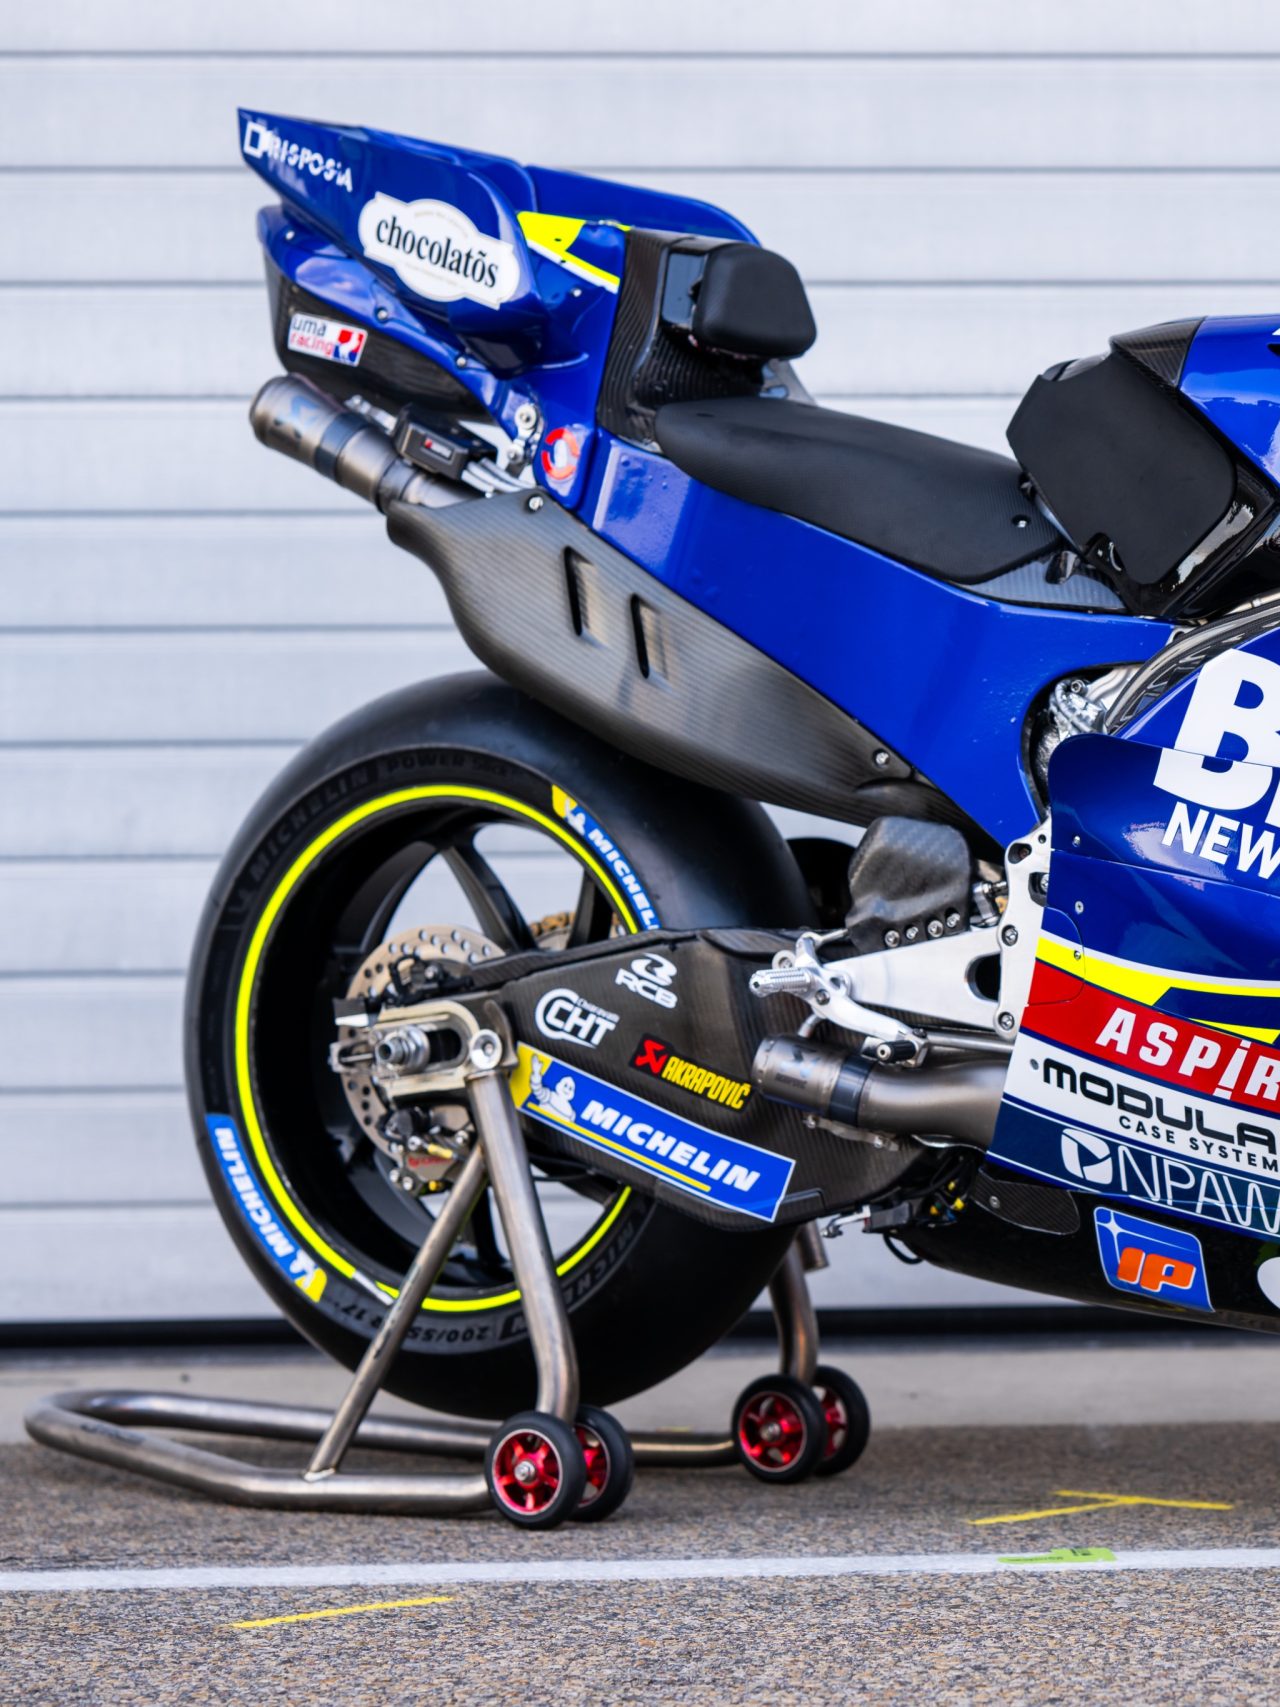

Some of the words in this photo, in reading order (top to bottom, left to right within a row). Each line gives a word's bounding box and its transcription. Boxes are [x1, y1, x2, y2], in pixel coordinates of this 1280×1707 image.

[290, 331, 334, 356] racing
[292, 317, 327, 337] uma
[615, 967, 678, 1009] RCB
[545, 998, 617, 1047] CHT
[1042, 1058, 1277, 1153] MODULA
[581, 1099, 761, 1193] MICHELIN
[1119, 1115, 1176, 1144] CASE
[1188, 1136, 1279, 1173] SYSTEM
[214, 1127, 295, 1258] MICHELIN
